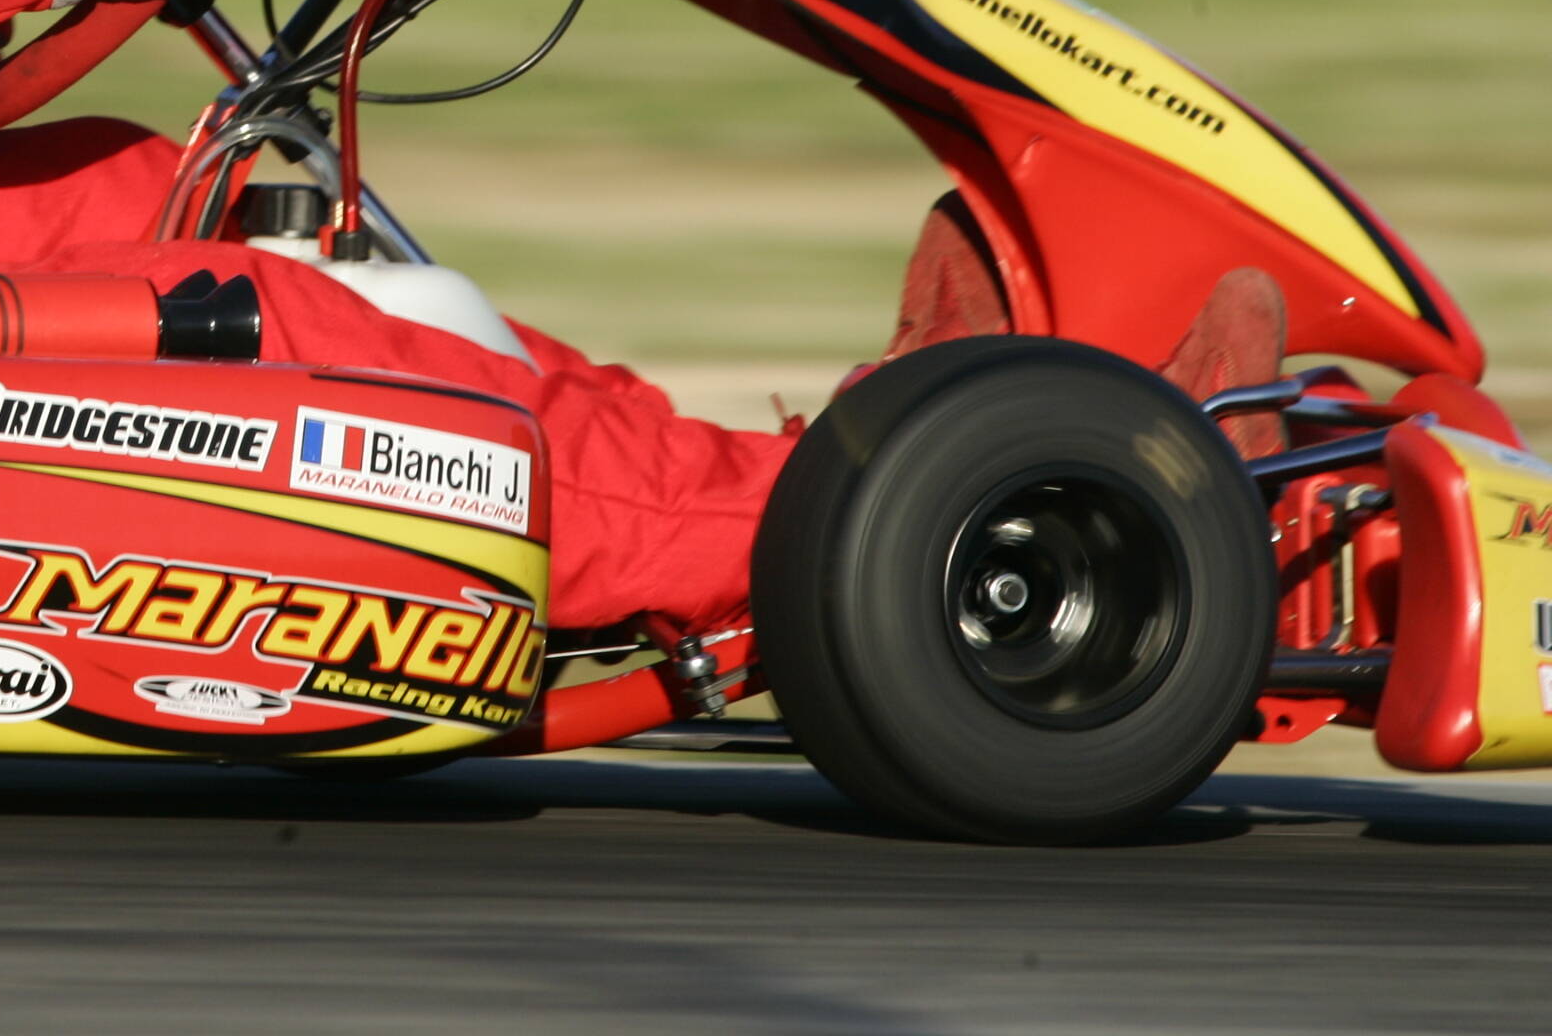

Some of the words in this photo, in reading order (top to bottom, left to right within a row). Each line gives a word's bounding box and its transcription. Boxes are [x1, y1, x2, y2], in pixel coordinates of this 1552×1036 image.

[298, 467, 445, 506] MARANELLO
[449, 495, 525, 526] RACING
[369, 431, 494, 497] Bianchi
[503, 460, 526, 506] J.
[312, 668, 456, 716] Racing
